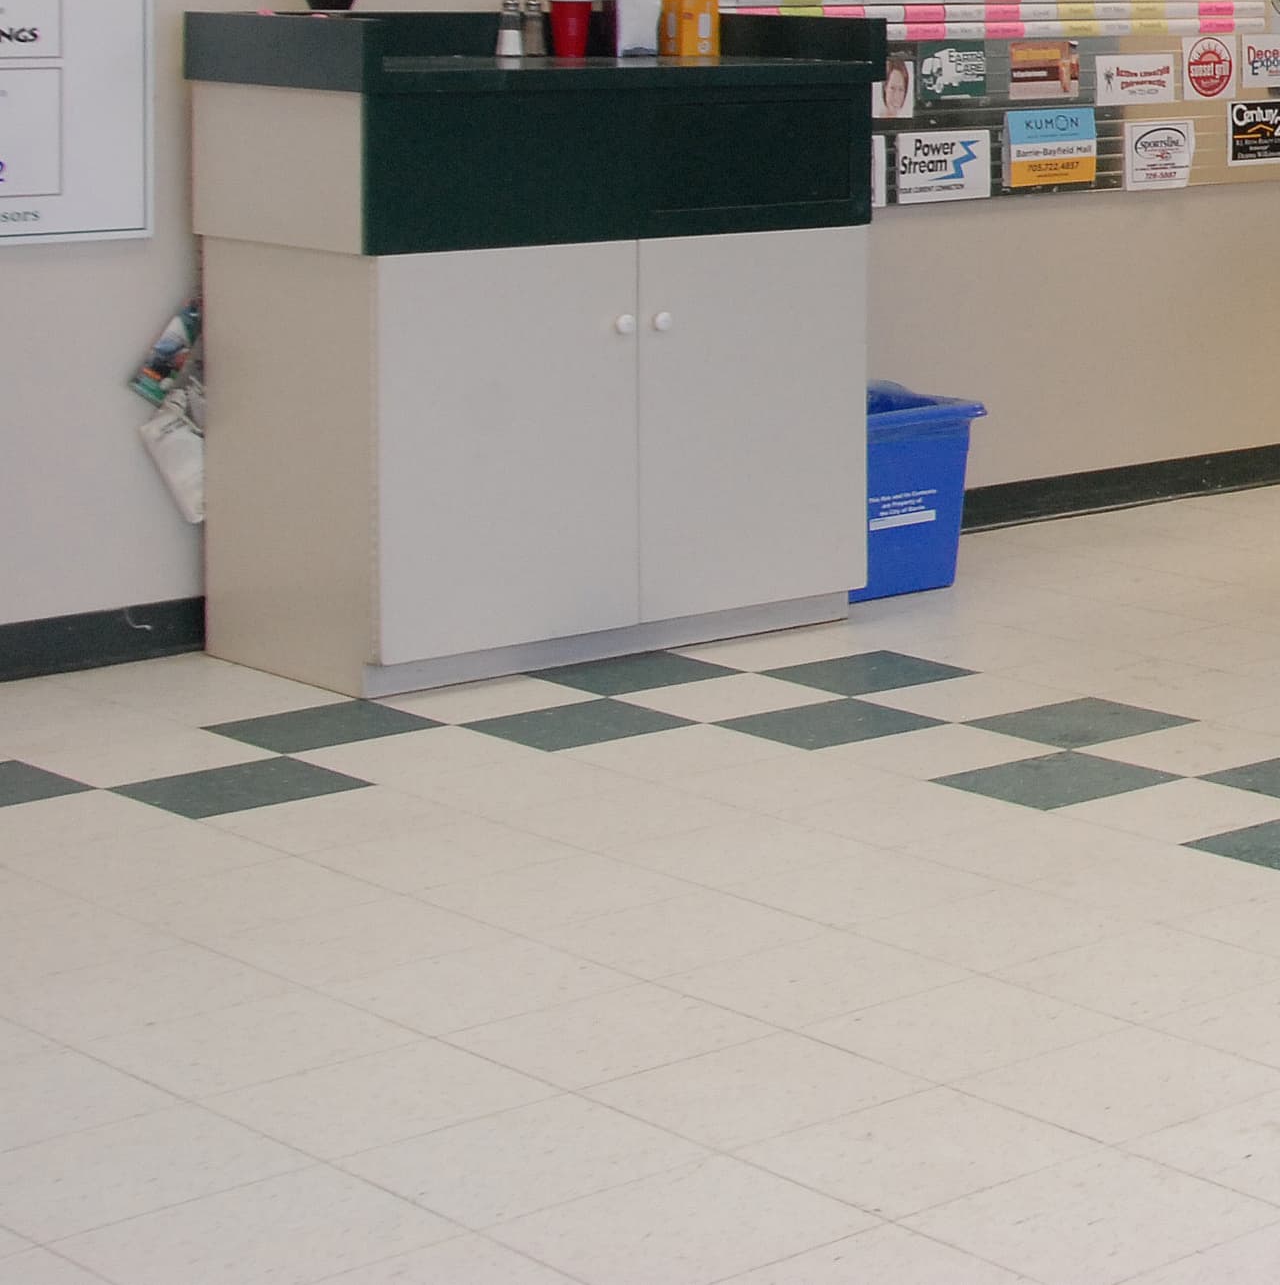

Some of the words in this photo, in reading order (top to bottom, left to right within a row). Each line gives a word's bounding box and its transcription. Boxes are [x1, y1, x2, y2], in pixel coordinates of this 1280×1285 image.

[956, 62, 985, 74] CARE
[1025, 114, 1079, 131] KUMON
[1233, 104, 1278, 126] Century
[914, 139, 956, 156] Power
[1016, 145, 1074, 158] Barrie-Bayfield
[1076, 144, 1092, 154] Mall
[900, 156, 947, 175] Stream
